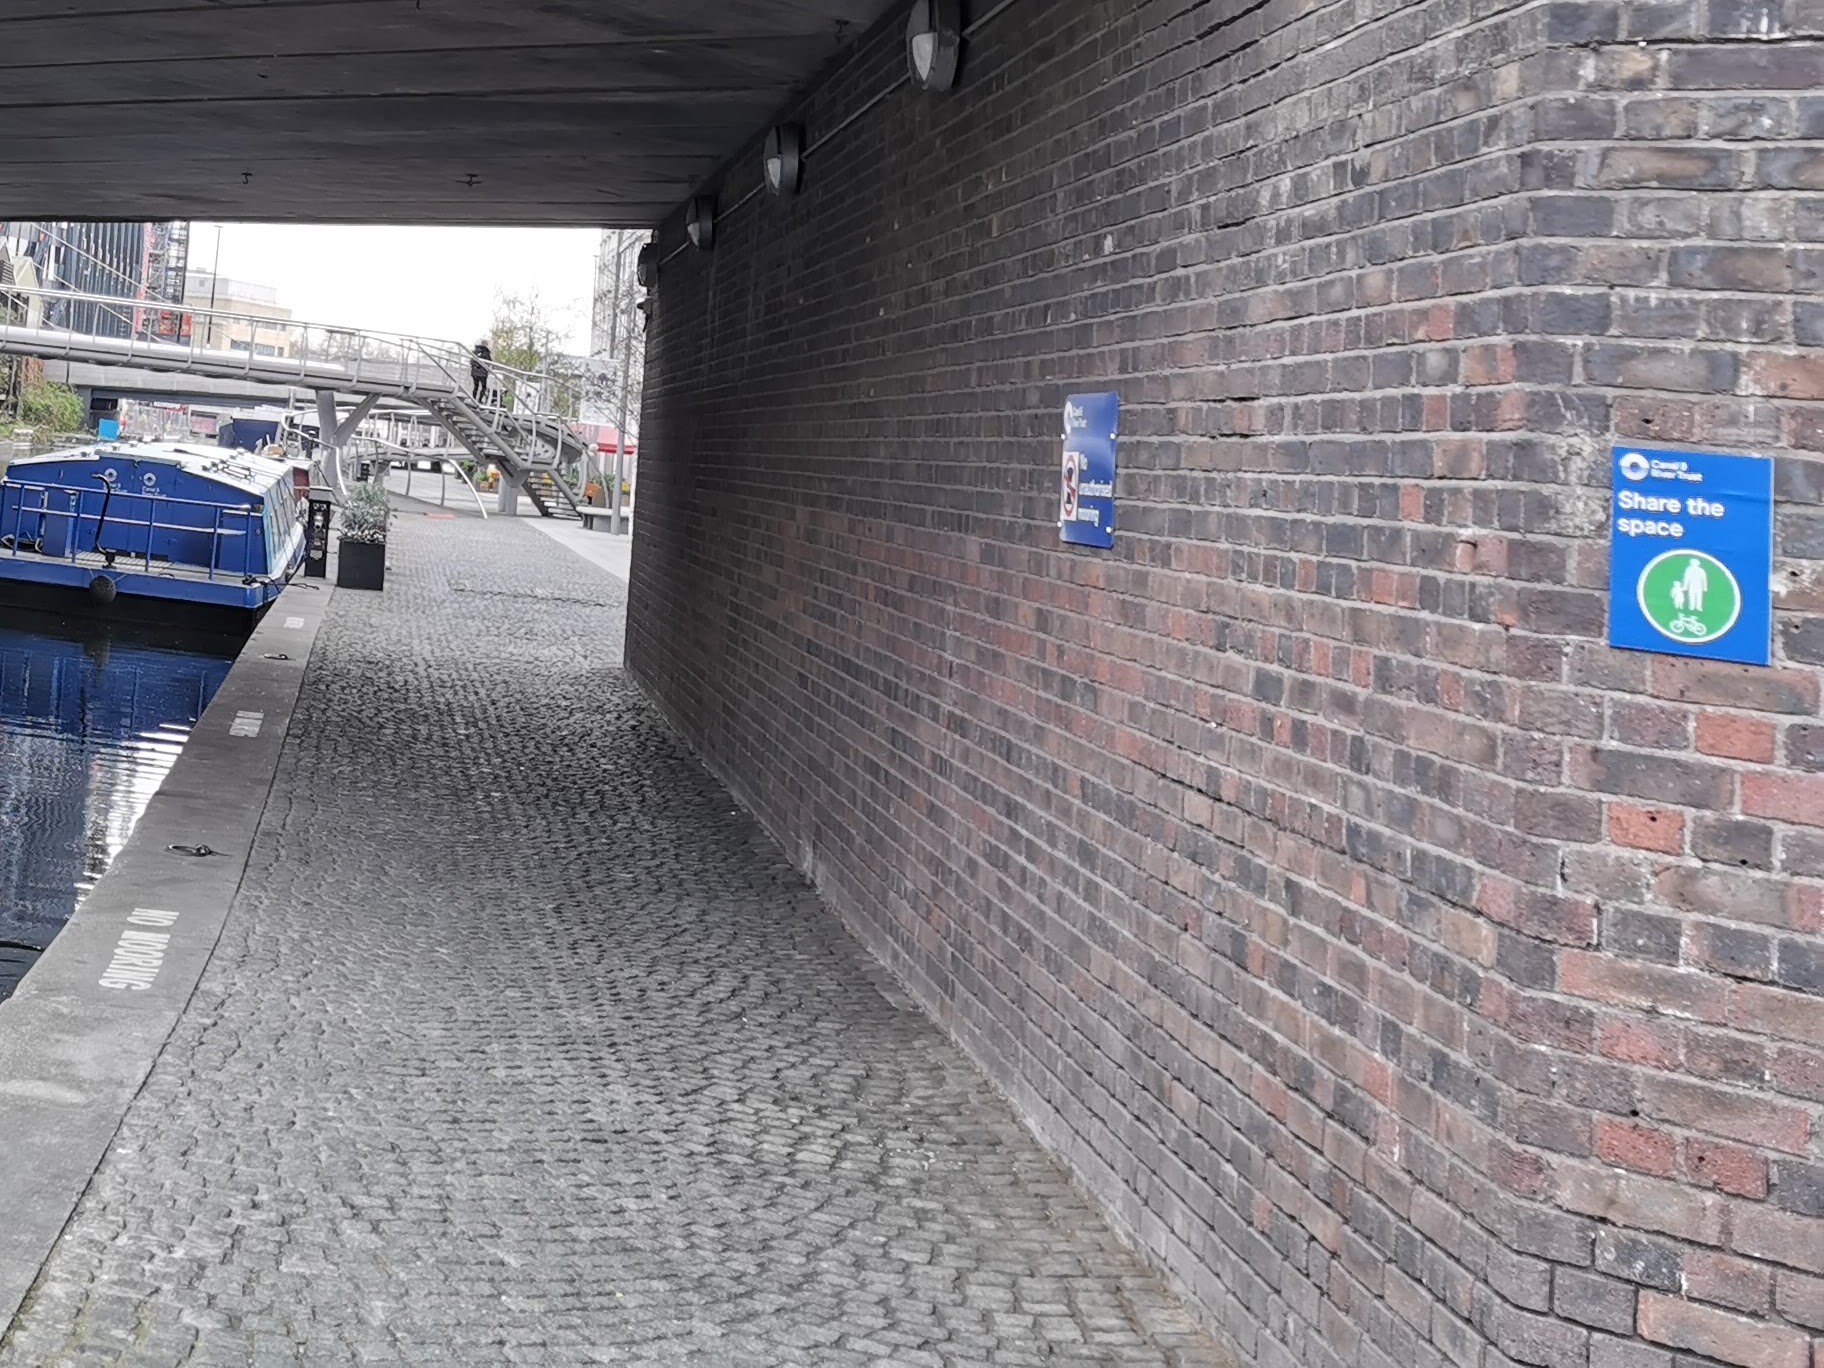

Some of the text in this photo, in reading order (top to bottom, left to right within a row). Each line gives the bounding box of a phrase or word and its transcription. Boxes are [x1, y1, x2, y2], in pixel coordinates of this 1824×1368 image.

[1617, 489, 1725, 518] Share the
[1617, 518, 1684, 538] space
[98, 907, 180, 991] NO MOORING
